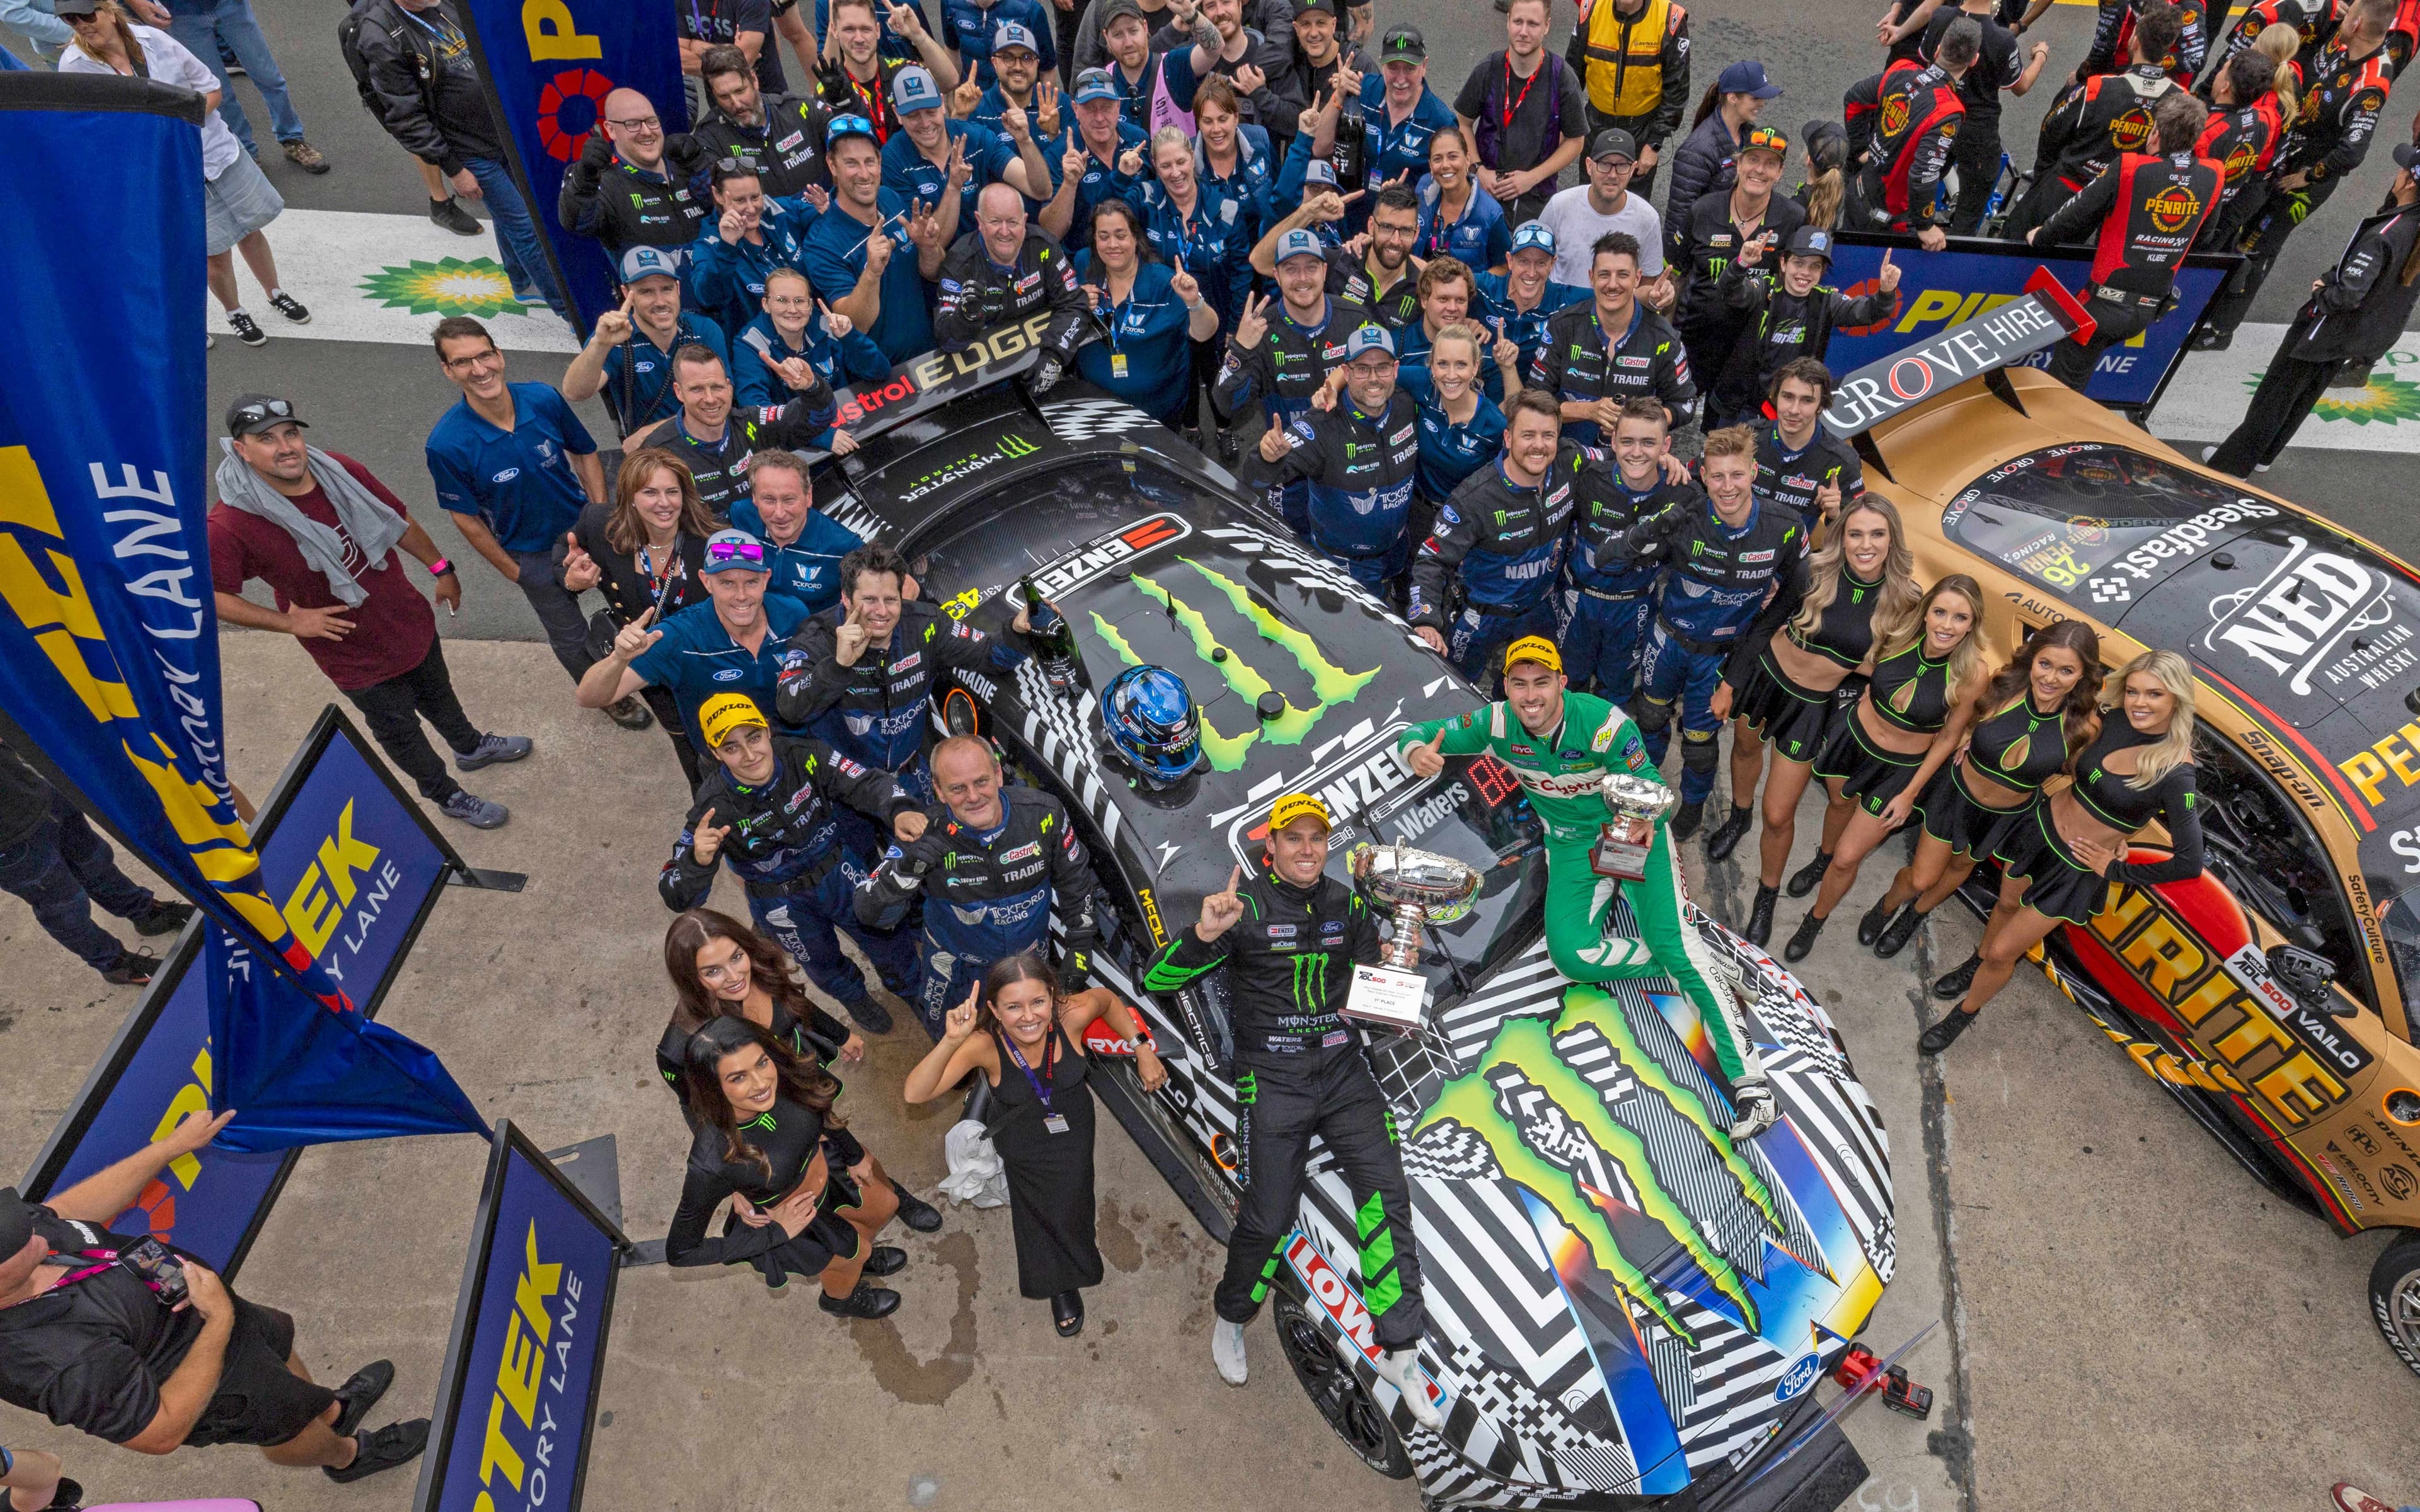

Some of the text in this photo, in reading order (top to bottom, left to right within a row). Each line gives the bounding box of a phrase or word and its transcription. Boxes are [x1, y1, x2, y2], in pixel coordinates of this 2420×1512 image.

[2109, 118, 2152, 137] PENRIT
[783, 147, 814, 171] TRADIE
[2225, 154, 2259, 171] ENRITE
[2145, 198, 2201, 215] PENRITE
[2136, 234, 2175, 244] RACING
[2146, 254, 2167, 262] KUBE
[1015, 287, 1045, 308] TRADIE
[1623, 357, 1650, 369] Castrol
[1823, 299, 2054, 430] GROVE HIRE
[1613, 374, 1649, 386] TRADIE
[829, 374, 916, 428] astrol
[1393, 424, 1414, 444] Castrol
[694, 471, 722, 481] MONSTER
[898, 451, 1004, 503] MONSTER
[909, 453, 979, 489] ENERGY
[1789, 475, 1817, 491] Castrol
[1986, 457, 2036, 484] GROVE
[1383, 493, 1409, 511] RACING
[1550, 484, 1569, 507] Castrol
[1775, 491, 1811, 507] TRADIE
[1942, 488, 1981, 526] GROVE
[1546, 500, 1574, 527] TRADIE
[89, 462, 203, 639] LANE
[1703, 545, 1728, 557] MONSTER
[2012, 532, 2057, 561] RACING
[2124, 498, 2280, 580] Steadfast
[1027, 537, 1134, 598] ENZED
[1506, 556, 1550, 580] NAVY
[1746, 550, 1774, 562] Castrol
[1736, 568, 1774, 580] TRADIE
[2043, 554, 2091, 587] 26
[792, 580, 822, 590] TICKFORD
[1712, 587, 1764, 604] TICKFORD
[1712, 597, 1743, 607] RACING
[2218, 552, 2373, 679] NED
[1510, 639, 1554, 656] DUNLOP
[2324, 623, 2414, 685] AUSTRALIAN
[894, 653, 921, 673] Castrol
[2358, 648, 2419, 690] WHISKY
[890, 670, 927, 694] TRADIE
[705, 702, 752, 728] DUNLOP
[879, 698, 928, 729] TICKFORD
[880, 719, 913, 736] RACING
[1162, 728, 1200, 752] MONSTER
[1311, 741, 1414, 823] ENZE
[2240, 730, 2326, 811] Snap-on
[790, 781, 812, 812] Castrol
[1279, 799, 1326, 815] DUNLOP
[1393, 779, 1470, 842] Waters
[957, 854, 985, 863] MONSTER
[1003, 859, 1046, 883] TRADIE
[343, 859, 401, 955] LANE
[988, 889, 1046, 920] TICKFORD
[993, 909, 1029, 927] RACING
[1276, 926, 1295, 935] ENZED
[2348, 874, 2385, 965] SafetyCulture
[1358, 975, 1386, 984] ADL500
[2232, 959, 2295, 1013] ADL500
[930, 980, 948, 1021] TICKFORD
[1708, 966, 1744, 1022] TICKFORD
[2087, 881, 2351, 1126] NRITE
[1277, 1012, 1340, 1028] MONSTER
[1289, 1024, 1332, 1034] ENERGY
[1268, 1035, 1303, 1043] WATERS
[2297, 1011, 2361, 1070] VAILO
[1013, 1050, 1027, 1067] GUEST
[1241, 1107, 1251, 1187] MONSTER
[2347, 1127, 2378, 1155] PPG
[1199, 1153, 1236, 1206] TRADERS
[2336, 1175, 2365, 1210] Repco
[2339, 1153, 2385, 1207] VELOCITY
[2382, 1166, 2411, 1201] ACL
[1292, 1246, 1385, 1359] LOW
[550, 1269, 583, 1394] LANE
[471, 1217, 563, 1512] TEK
[1783, 1359, 1814, 1397] Ford
[1519, 1491, 1543, 1499] BRAKES
[1543, 1493, 1576, 1501] AUSTRALIA
